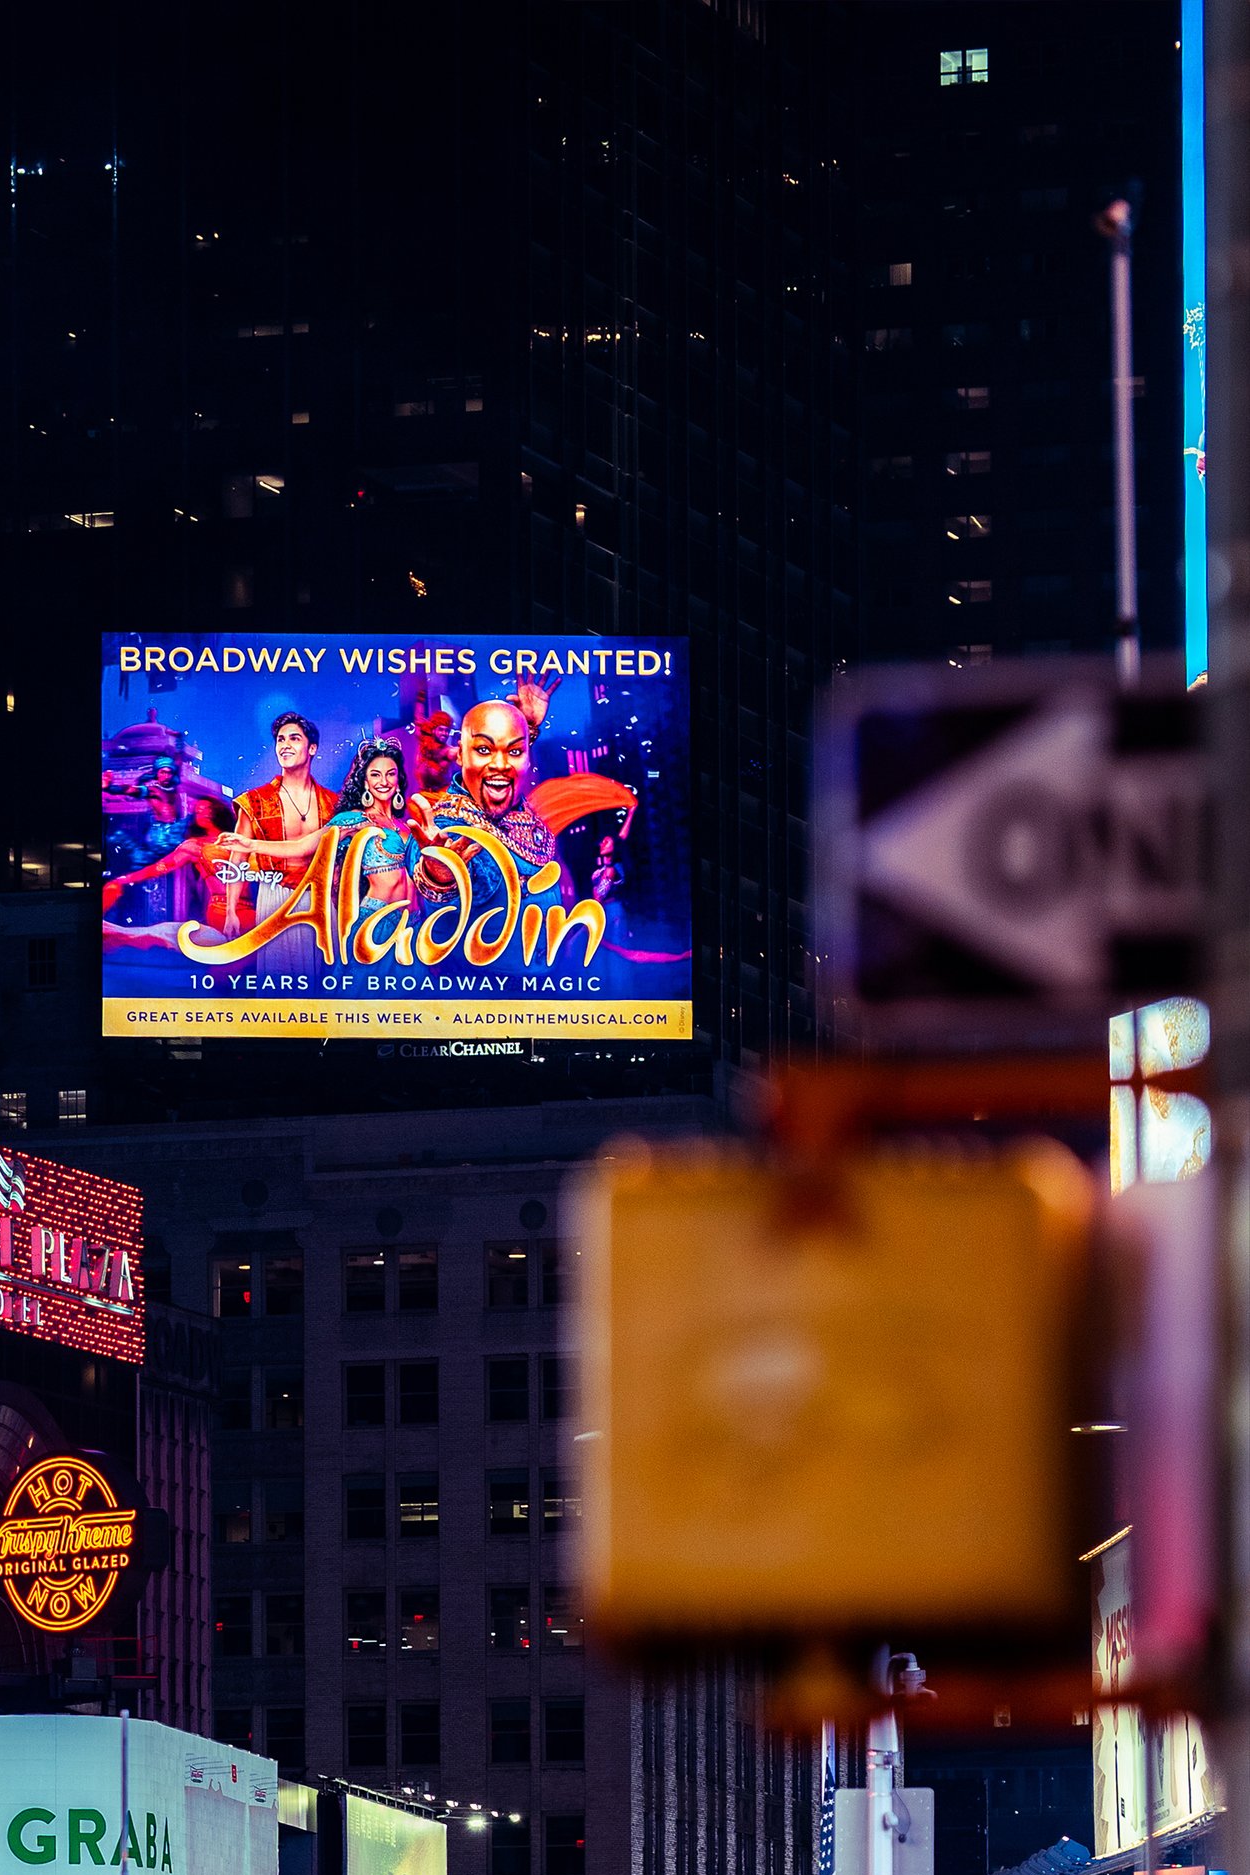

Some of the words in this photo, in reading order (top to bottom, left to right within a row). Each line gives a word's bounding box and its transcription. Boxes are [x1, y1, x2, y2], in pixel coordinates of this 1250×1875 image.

[120, 646, 326, 673] BROADWAY
[339, 648, 476, 674] WISHES
[489, 649, 672, 676] GRANTED!
[958, 780, 1210, 915] ON
[177, 825, 607, 967] Aladdin
[190, 975, 215, 990] 10
[228, 975, 309, 990] YEARS
[322, 975, 354, 991] OF
[367, 976, 508, 991] BROADWAY
[523, 976, 601, 992] MAGIC
[127, 1011, 178, 1023] GREAT
[185, 1011, 234, 1024] SEATS
[240, 1012, 328, 1024] AVAILABLE
[335, 1012, 370, 1024] THIS
[377, 1013, 423, 1025] WEEK
[453, 1013, 667, 1025] ALADDINTHEMUSICAL.COM
[31, 1226, 135, 1300] PLAZA
[27, 1469, 93, 1508] HOT
[60, 1510, 136, 1553] Kreme
[72, 1554, 130, 1570] GLAZED
[27, 1576, 97, 1619] NOW
